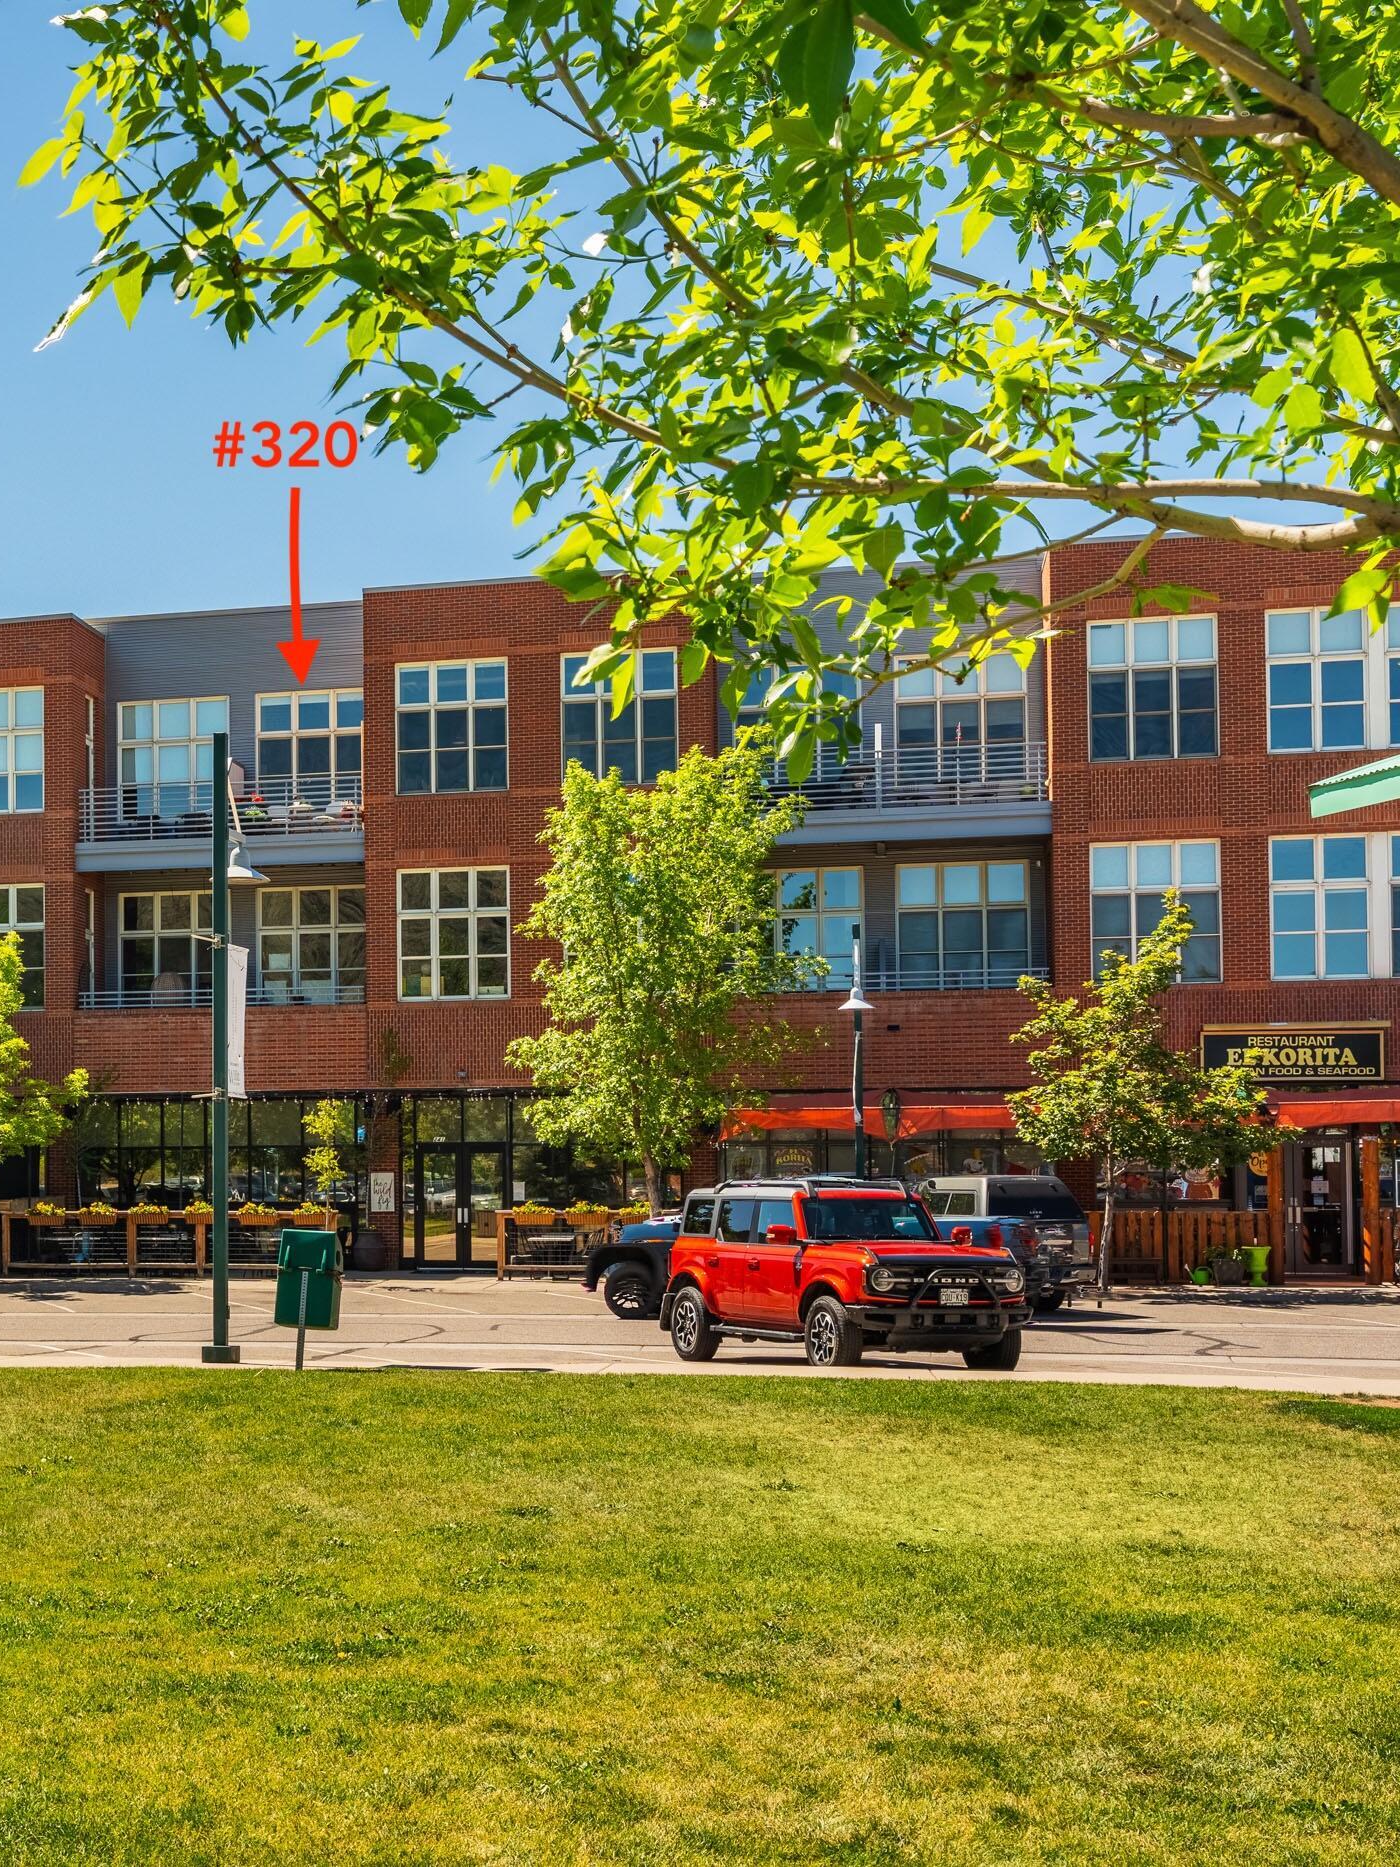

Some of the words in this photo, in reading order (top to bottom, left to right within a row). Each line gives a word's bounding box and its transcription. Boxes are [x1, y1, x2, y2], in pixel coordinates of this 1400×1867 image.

[1247, 1036, 1336, 1047] RESTAURANT
[1262, 1047, 1358, 1066] KORITA
[1268, 1067, 1302, 1075] FOOD
[1305, 1067, 1315, 1075] &
[1317, 1066, 1376, 1075] SEAFOOD
